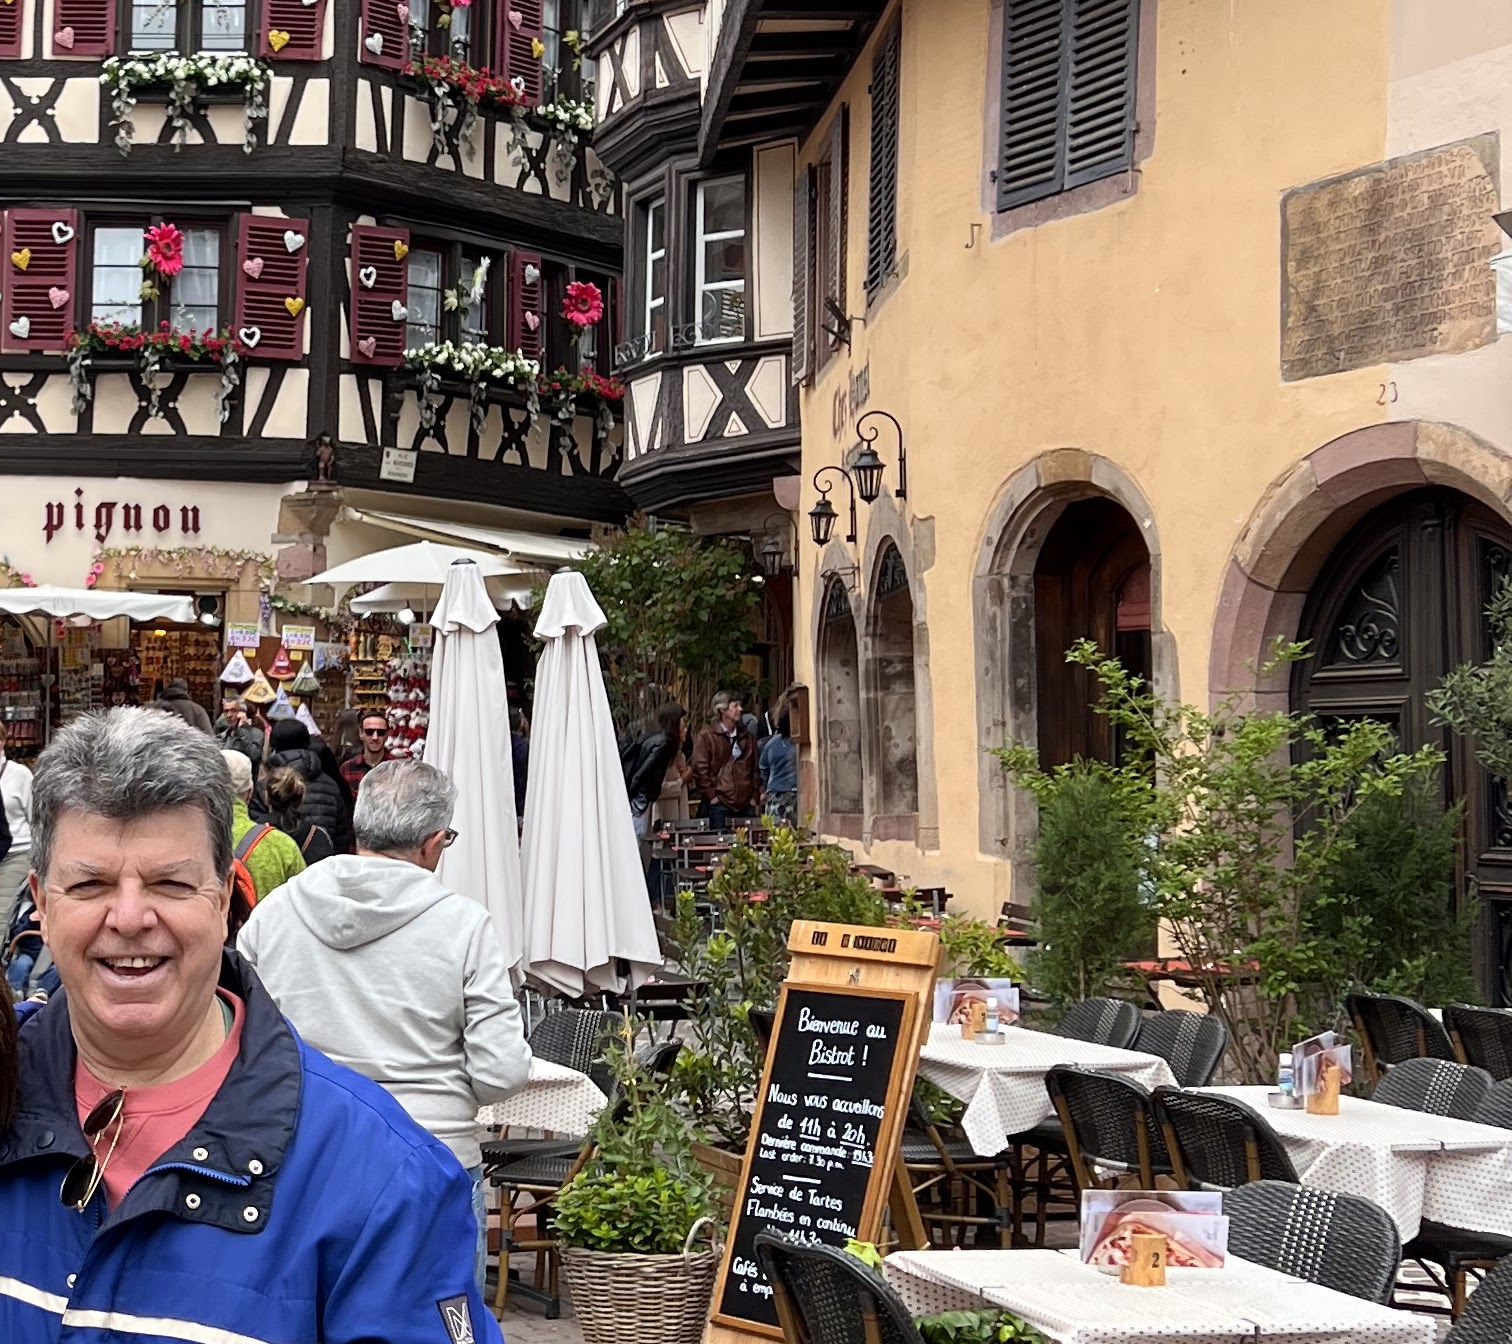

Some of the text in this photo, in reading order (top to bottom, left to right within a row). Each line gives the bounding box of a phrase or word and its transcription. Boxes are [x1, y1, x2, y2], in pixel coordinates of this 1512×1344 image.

[1375, 381, 1399, 406] 23
[42, 487, 203, 545] pignon
[798, 1007, 887, 1039] Bienvenue au
[807, 1039, 856, 1066] Bistrot
[768, 1083, 798, 1106] Nous
[804, 1094, 828, 1109] vous
[777, 1114, 794, 1130] de
[799, 1116, 822, 1137] 11h
[826, 1120, 837, 1139] à
[750, 1175, 843, 1212] Service de Tartes
[746, 1198, 795, 1224] Flambées
[798, 1214, 812, 1227] en
[816, 1216, 857, 1238] continu
[732, 1256, 759, 1279] Cafés
[1151, 1252, 1161, 1269] 2
[739, 1278, 748, 1293] à
